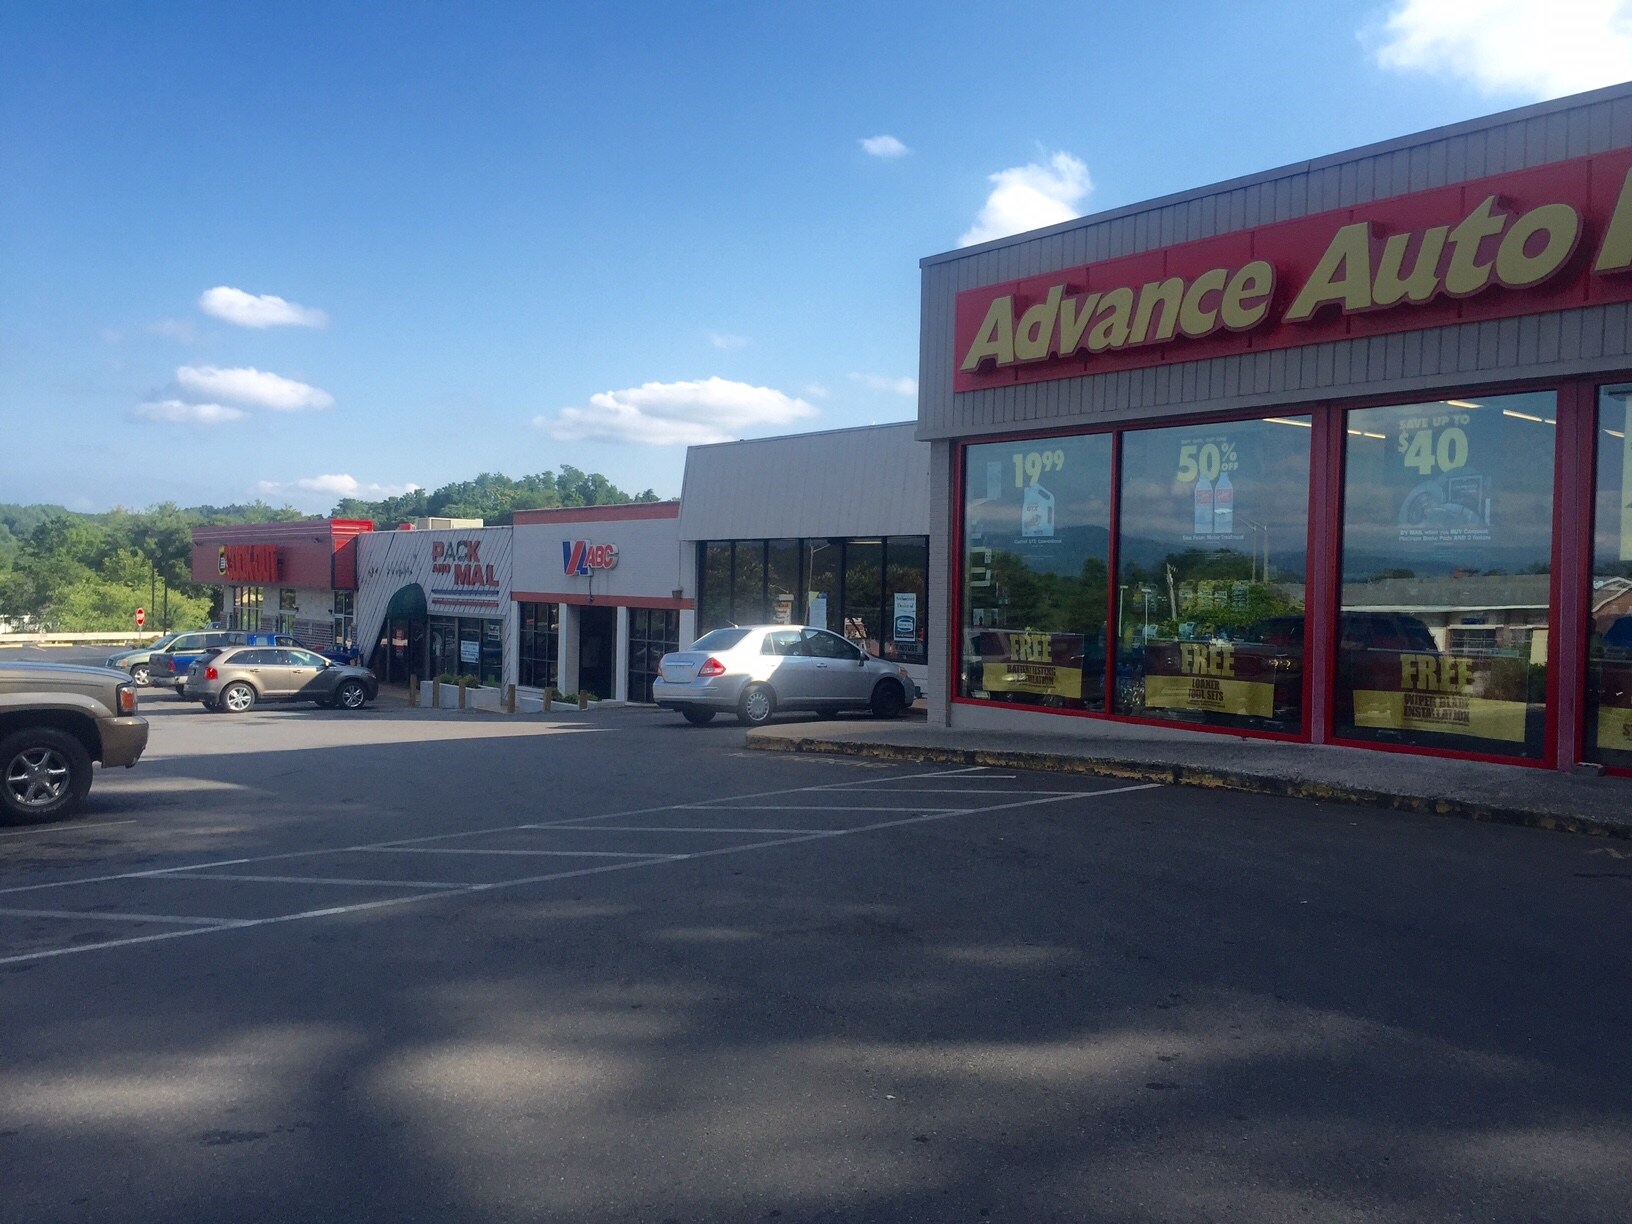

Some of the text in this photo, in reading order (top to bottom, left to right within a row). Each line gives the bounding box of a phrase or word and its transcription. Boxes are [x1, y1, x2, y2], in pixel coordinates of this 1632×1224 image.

[961, 260, 1276, 372] Advance
[1282, 196, 1583, 323] Auto
[1400, 414, 1470, 429] SAVE UP TO
[1398, 427, 1469, 475] $40
[1221, 462, 1239, 471] OFF
[432, 539, 481, 563] PACK
[584, 543, 615, 569] ABC
[1009, 633, 1053, 663] FREE
[1180, 643, 1235, 677] FREE
[1400, 654, 1474, 692] FREE
[1188, 688, 1224, 701] TOOL SETS
[1404, 693, 1435, 708] WIPER
[1404, 706, 1470, 724] INSTALLATION
